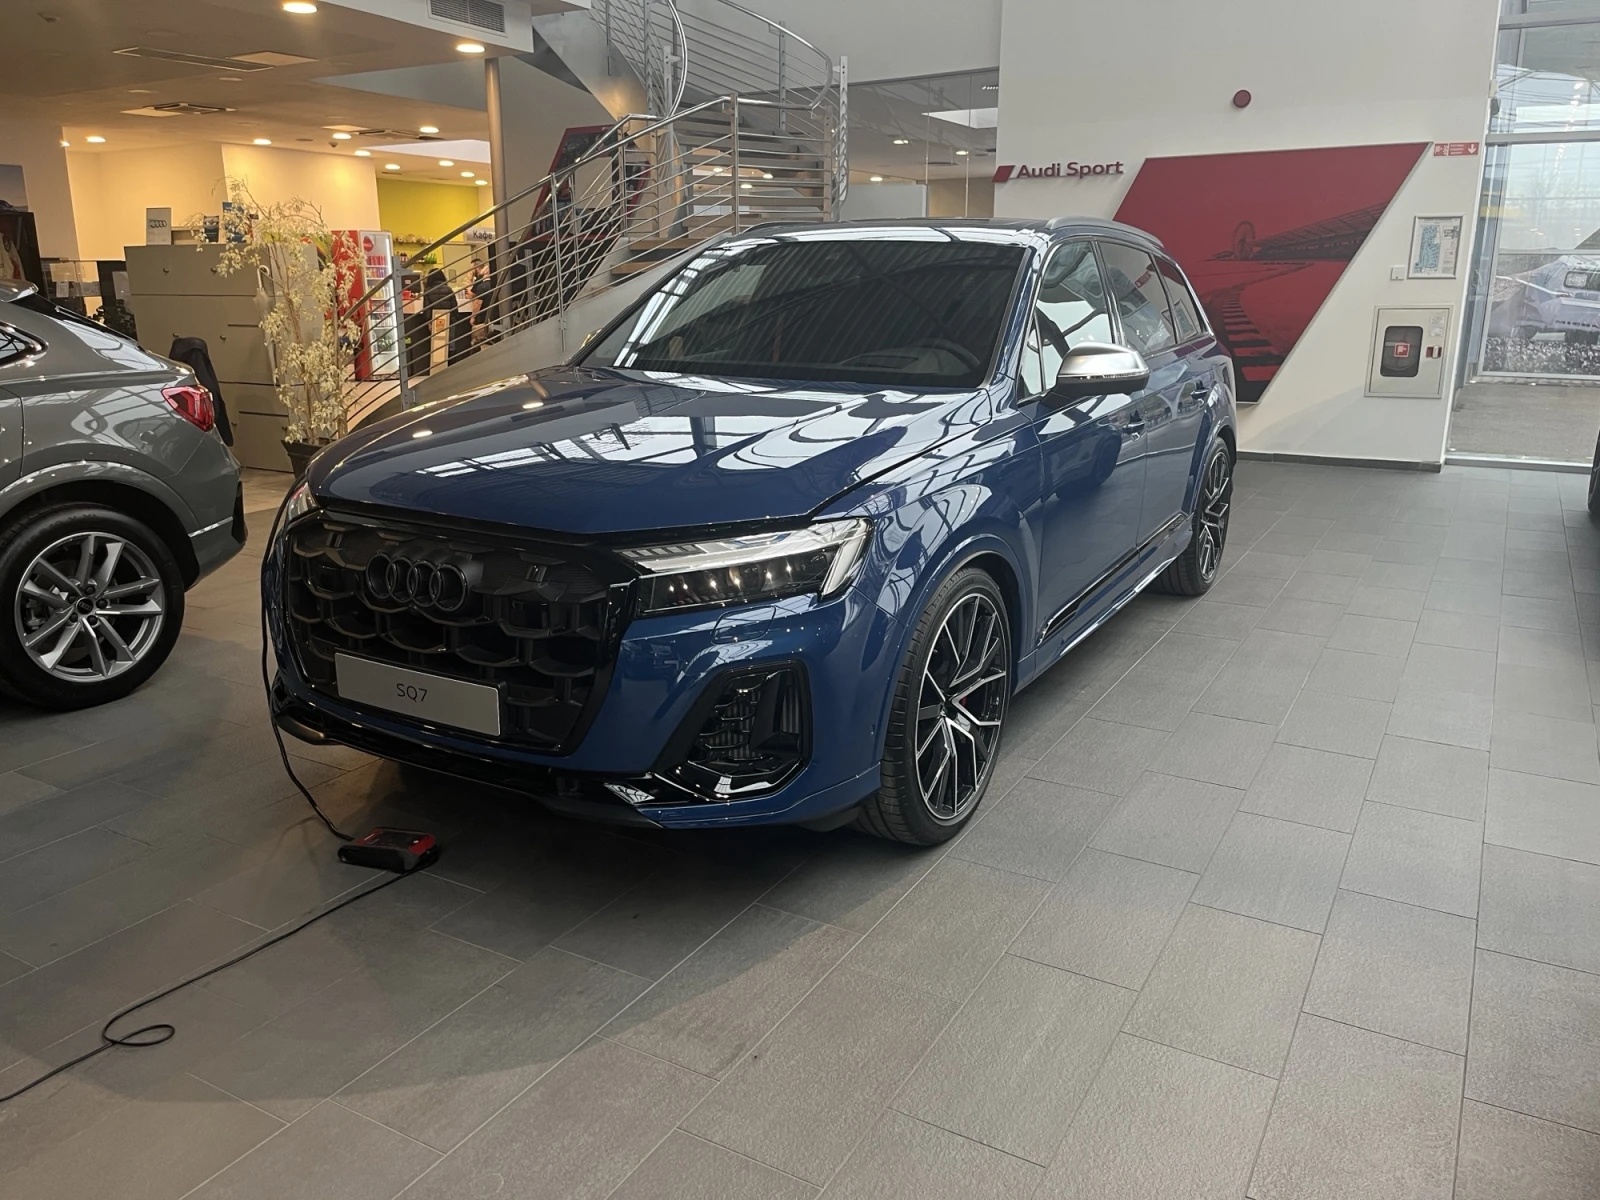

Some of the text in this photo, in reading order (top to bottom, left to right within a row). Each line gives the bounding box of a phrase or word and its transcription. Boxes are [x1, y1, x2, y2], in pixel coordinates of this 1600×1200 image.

[1017, 161, 1124, 179] Audi Sport
[473, 230, 493, 241] Кафе
[396, 683, 428, 703] SQ7
